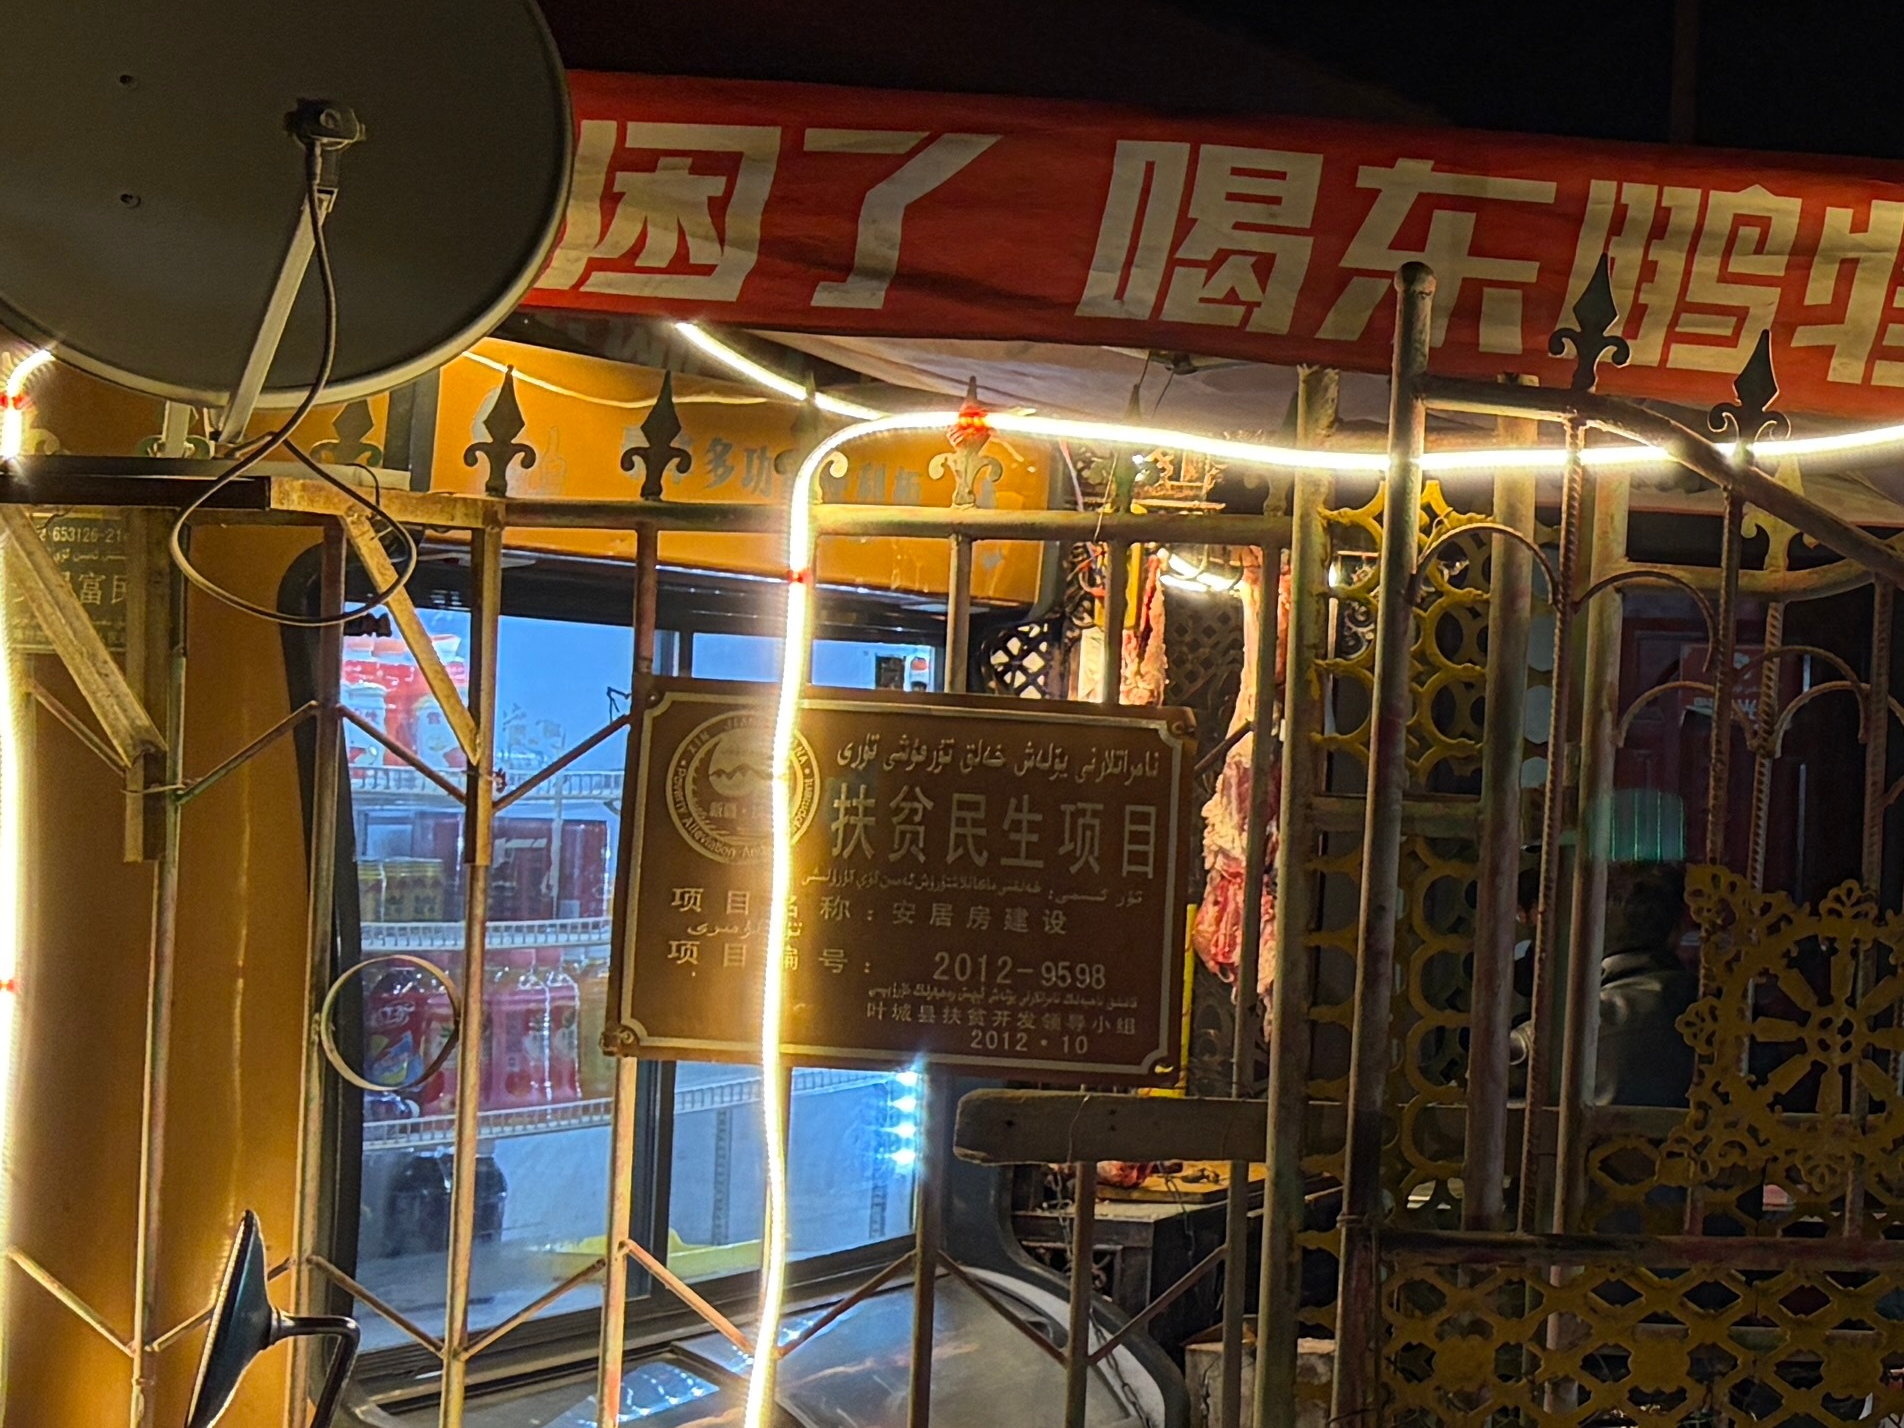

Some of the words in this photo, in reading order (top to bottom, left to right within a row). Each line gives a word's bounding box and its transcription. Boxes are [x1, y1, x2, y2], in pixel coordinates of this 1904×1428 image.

[533, 119, 1006, 310] 困了
[831, 782, 1157, 879] 扶贫民生项目
[933, 950, 1106, 990] 2012-9598
